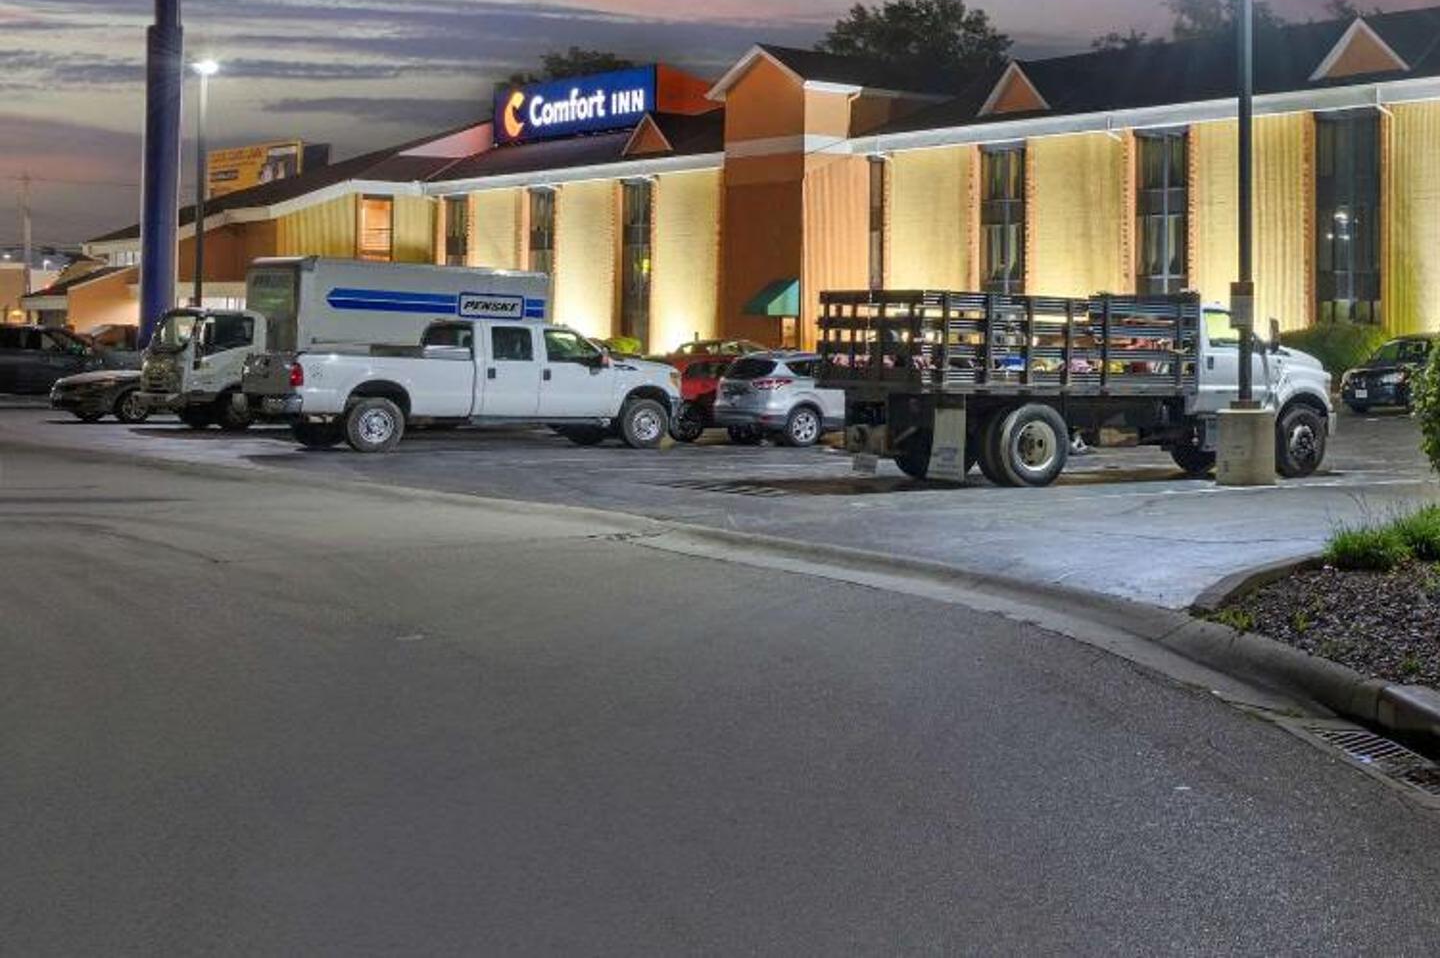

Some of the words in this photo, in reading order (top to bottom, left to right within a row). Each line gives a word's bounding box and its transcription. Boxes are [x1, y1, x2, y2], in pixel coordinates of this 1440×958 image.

[529, 88, 605, 127] Comfort
[611, 89, 644, 115] INN
[464, 300, 518, 312] PENSKE
